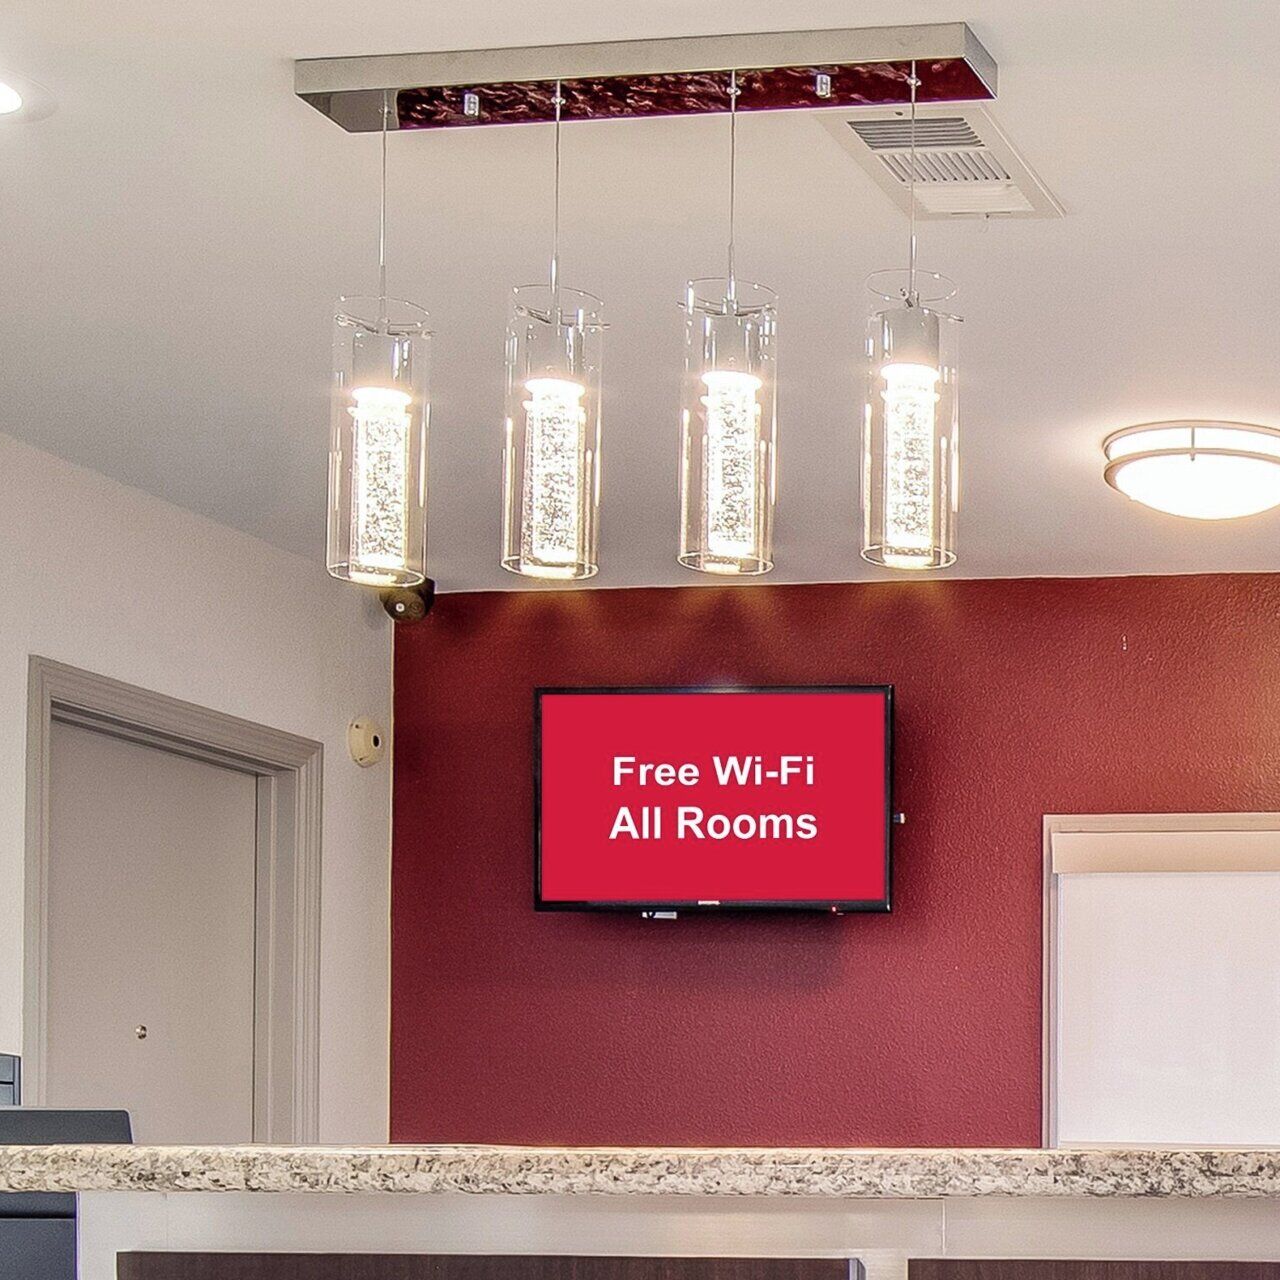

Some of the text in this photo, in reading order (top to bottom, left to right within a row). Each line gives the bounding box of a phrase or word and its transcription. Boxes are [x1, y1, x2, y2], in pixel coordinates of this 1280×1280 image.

[612, 755, 814, 786] Free Wi-Fi
[608, 806, 818, 840] All Rooms
